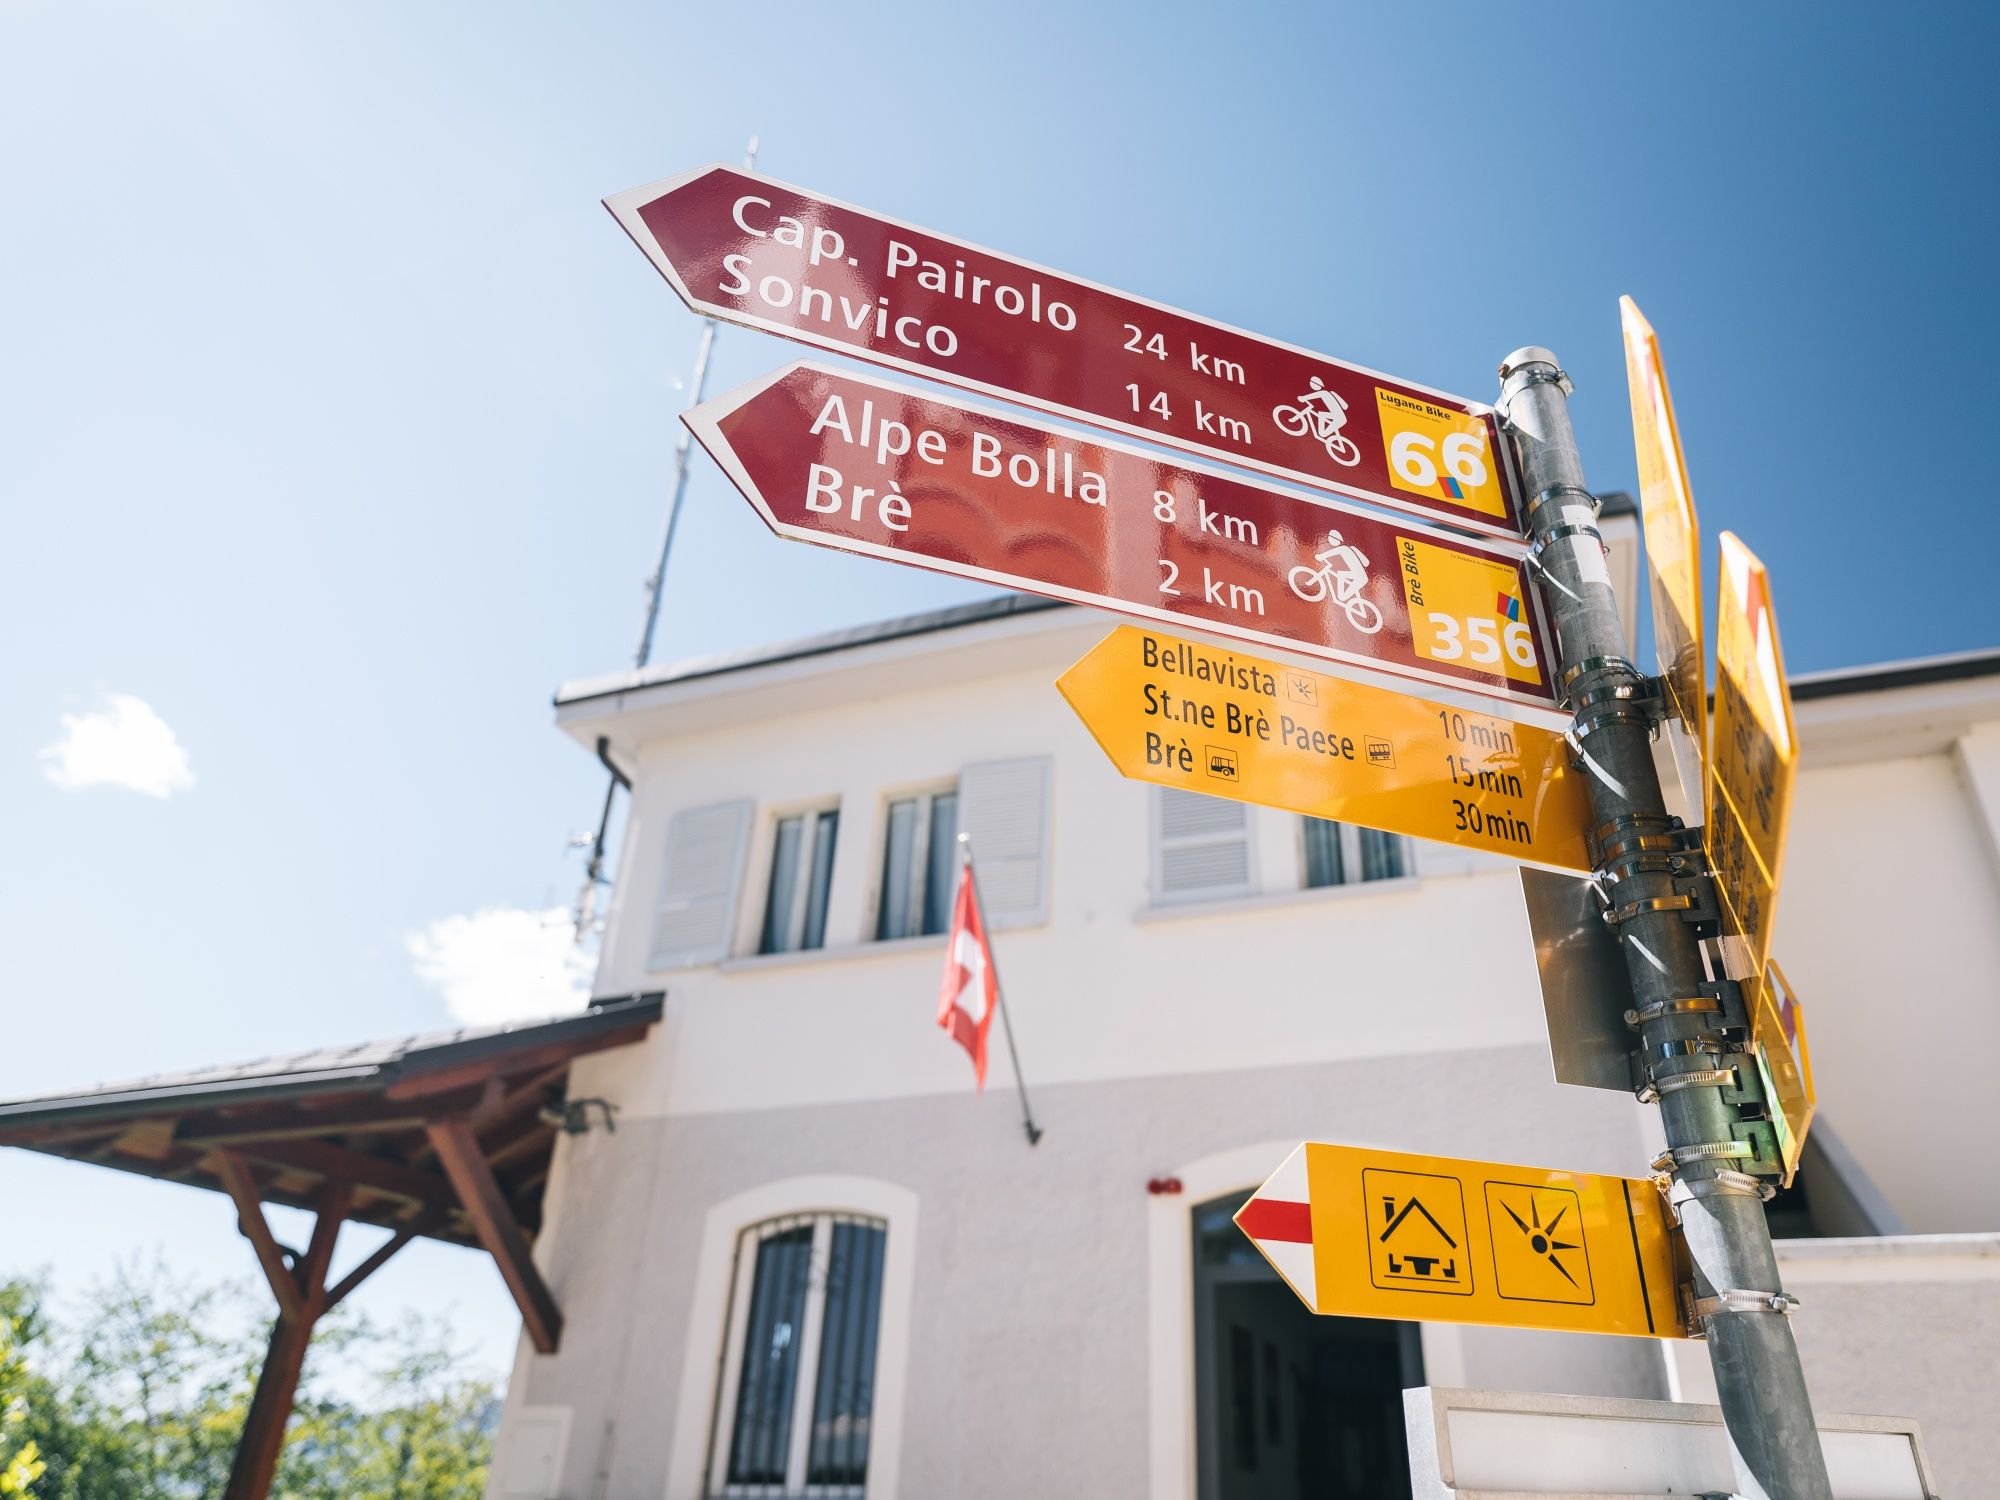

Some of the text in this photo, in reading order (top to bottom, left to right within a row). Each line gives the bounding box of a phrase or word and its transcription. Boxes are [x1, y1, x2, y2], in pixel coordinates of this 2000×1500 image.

[732, 195, 1245, 385] Cap. Pairolo 24 km
[718, 253, 1251, 444] Sonvico 14 km
[1380, 391, 1423, 411] Lugano
[1426, 405, 1451, 420] Bike
[809, 394, 1258, 545] Alpe Bolla 8 km
[1390, 431, 1487, 487] 66
[805, 463, 1265, 615] Brè 2 km
[1402, 541, 1424, 606] Brè Bike
[1143, 636, 1277, 697] Bellavista
[1427, 612, 1538, 669] 356
[1143, 683, 1355, 761] St.ne Brè Paese
[1146, 731, 1193, 773] Brè
